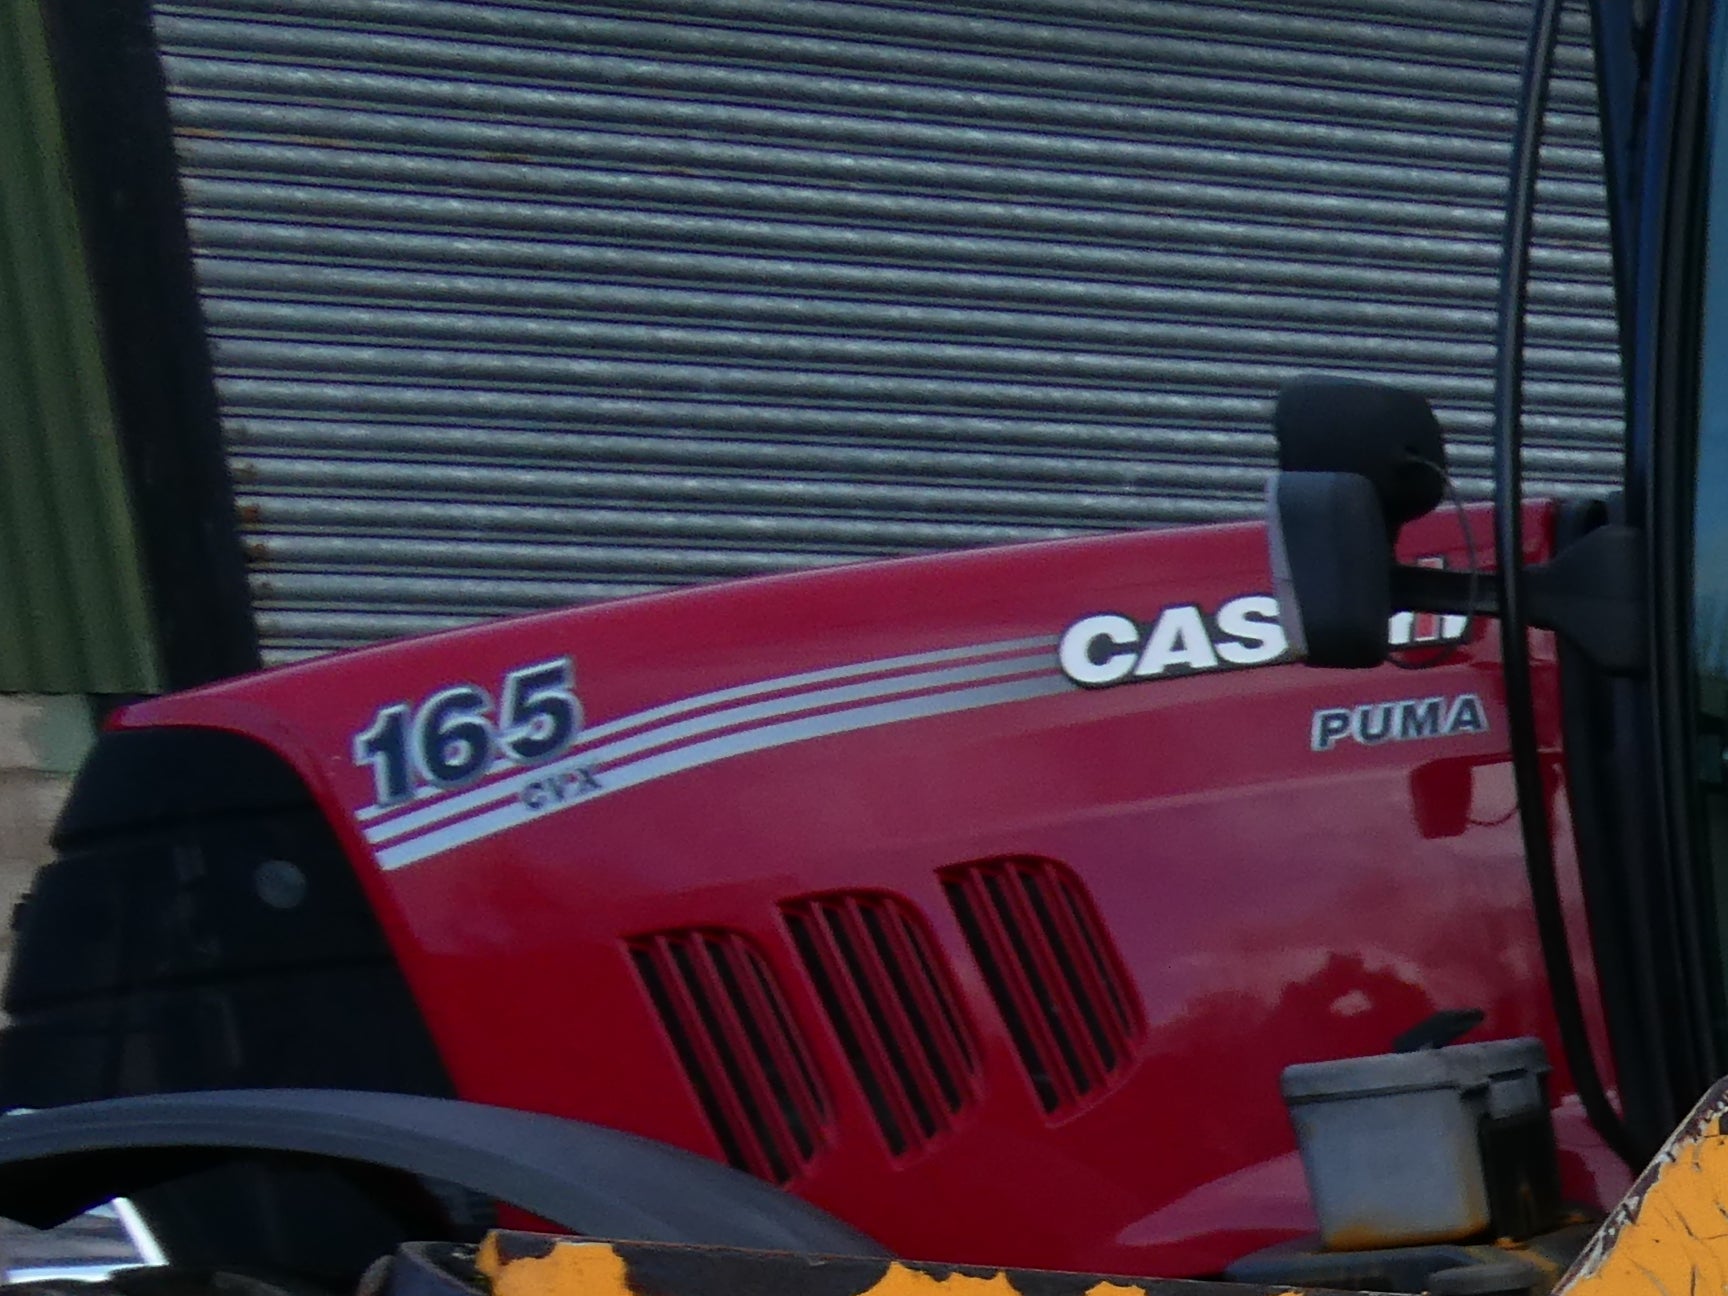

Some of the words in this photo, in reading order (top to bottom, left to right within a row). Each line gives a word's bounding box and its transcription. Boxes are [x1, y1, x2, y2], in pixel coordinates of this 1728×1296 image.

[1058, 594, 1290, 685] CAS
[352, 655, 584, 807] 165
[1311, 694, 1488, 752] PUMA
